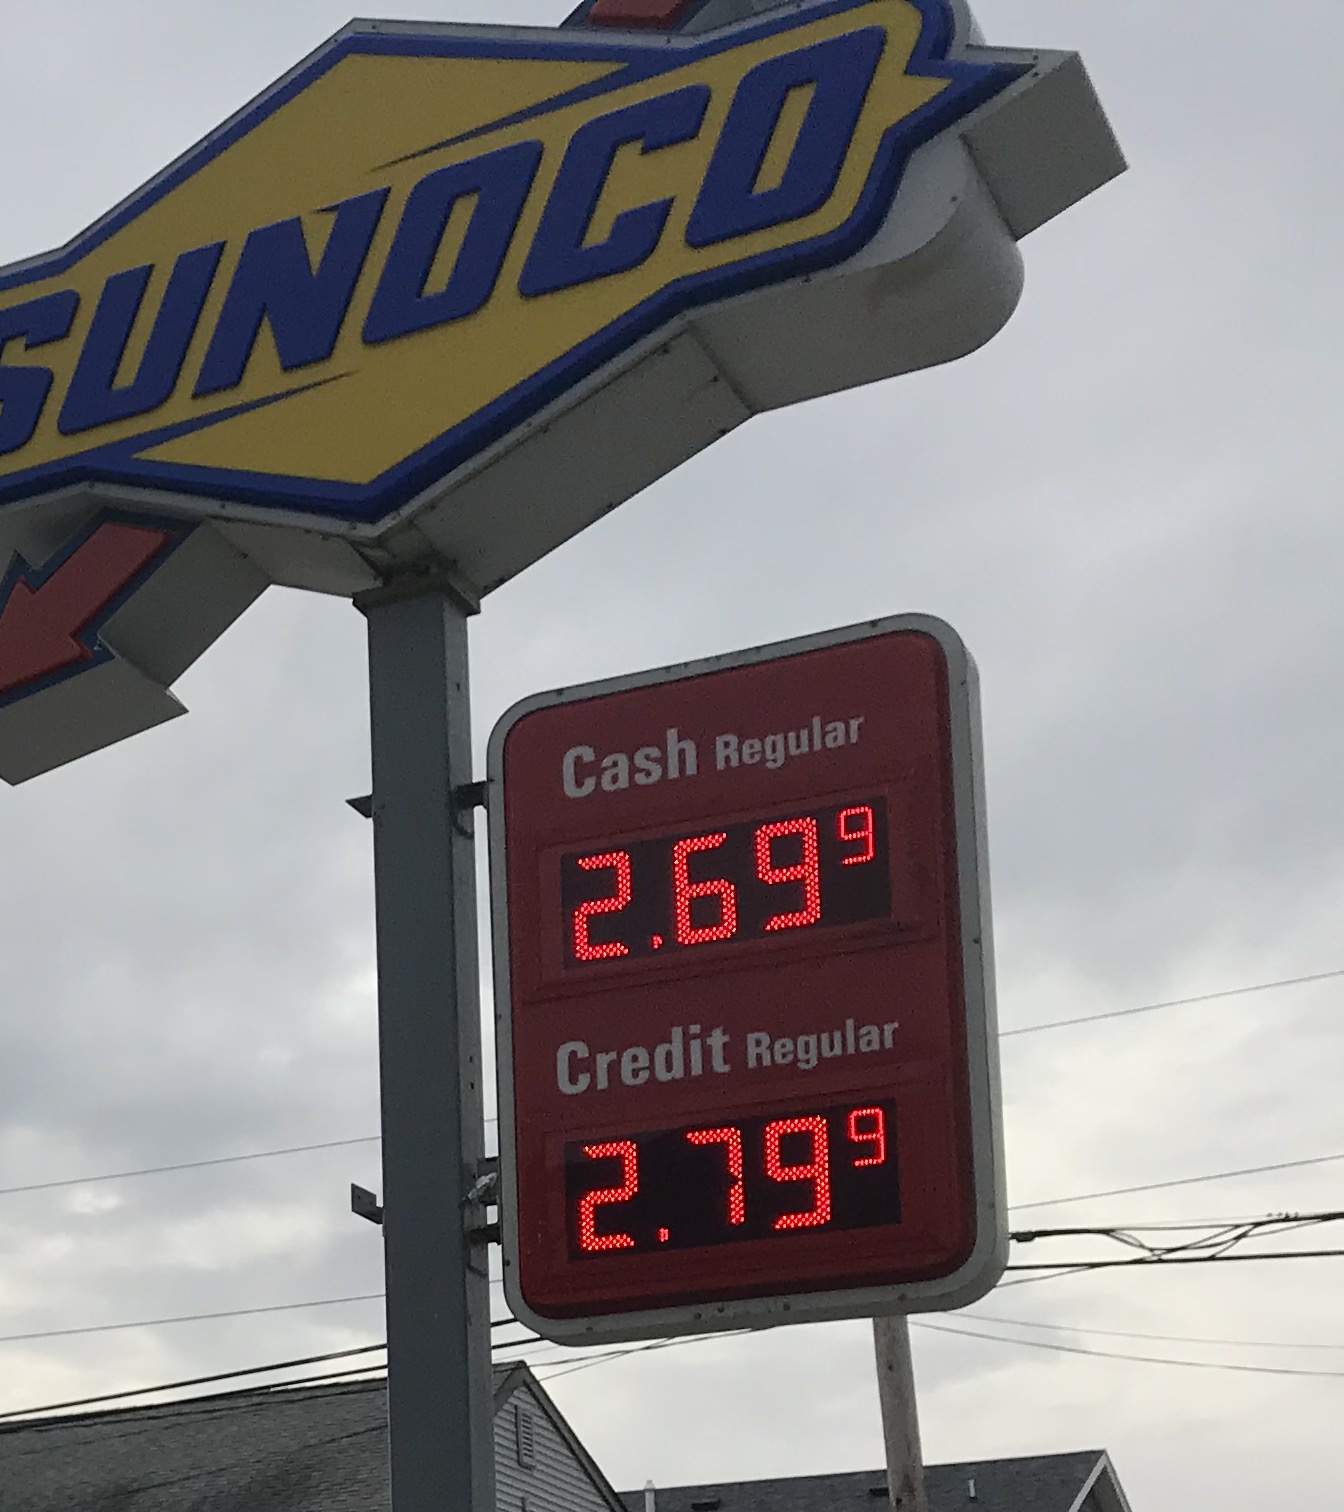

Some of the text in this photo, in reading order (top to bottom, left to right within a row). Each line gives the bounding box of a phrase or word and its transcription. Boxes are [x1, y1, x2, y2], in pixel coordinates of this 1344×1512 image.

[562, 715, 866, 799] Cash Regular
[556, 1018, 900, 1095] Credit Regular
